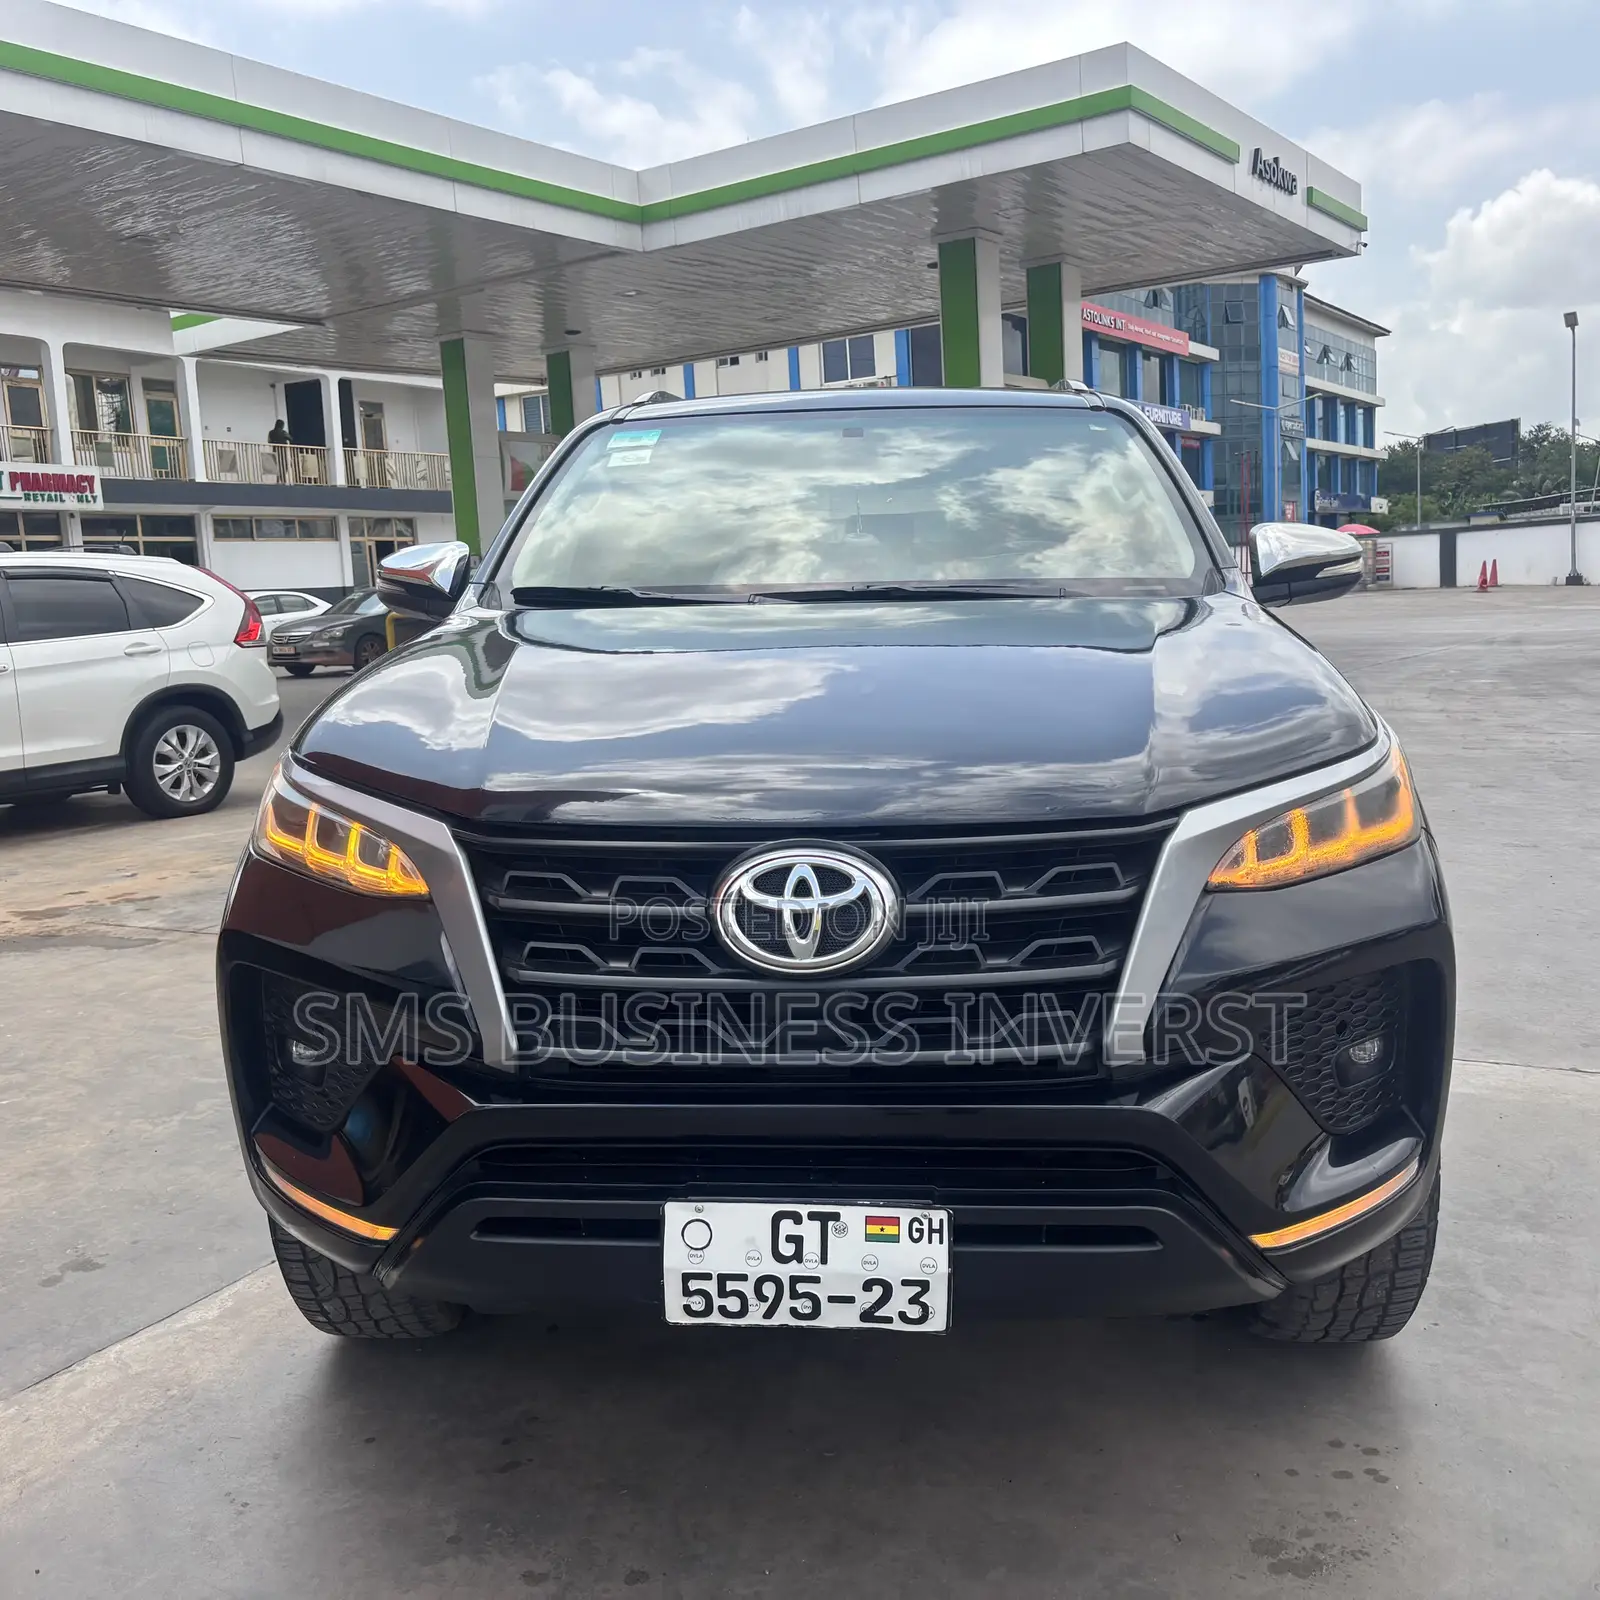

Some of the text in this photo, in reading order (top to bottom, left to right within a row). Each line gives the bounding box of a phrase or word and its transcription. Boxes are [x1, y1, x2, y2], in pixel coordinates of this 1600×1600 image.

[1252, 148, 1297, 195] Asokwa
[1082, 308, 1115, 329] ASTOLINKS
[1144, 405, 1183, 426] FURNITURE
[9, 471, 95, 494] PHARMACY
[24, 492, 65, 503] RETAIL
[771, 1209, 841, 1265] GT
[908, 1216, 944, 1245] GH
[681, 1272, 931, 1326] 5595-23
